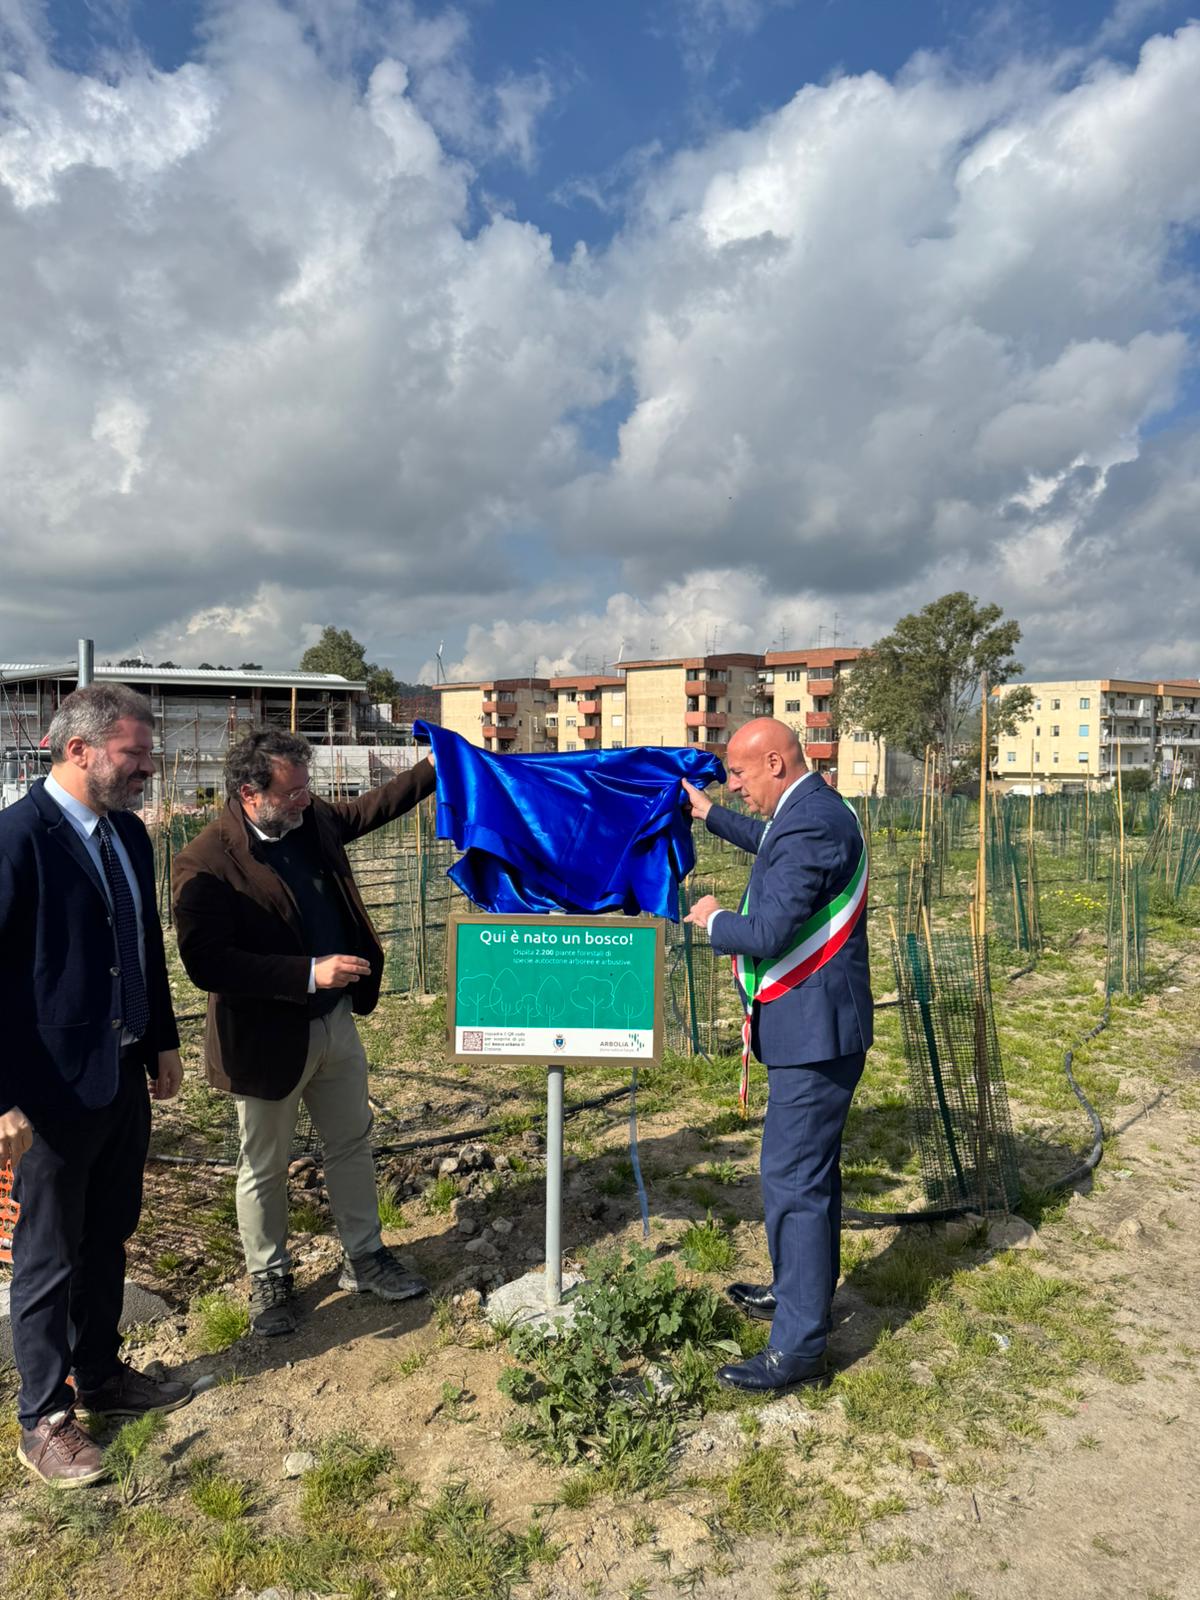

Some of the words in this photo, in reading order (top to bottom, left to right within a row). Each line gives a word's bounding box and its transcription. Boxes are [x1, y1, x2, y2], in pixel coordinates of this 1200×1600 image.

[480, 930, 506, 946] Qui
[510, 930, 519, 943] è
[524, 932, 558, 944] nato
[562, 934, 580, 944] un
[585, 932, 633, 946] bosco!
[513, 948, 534, 956] Ospita
